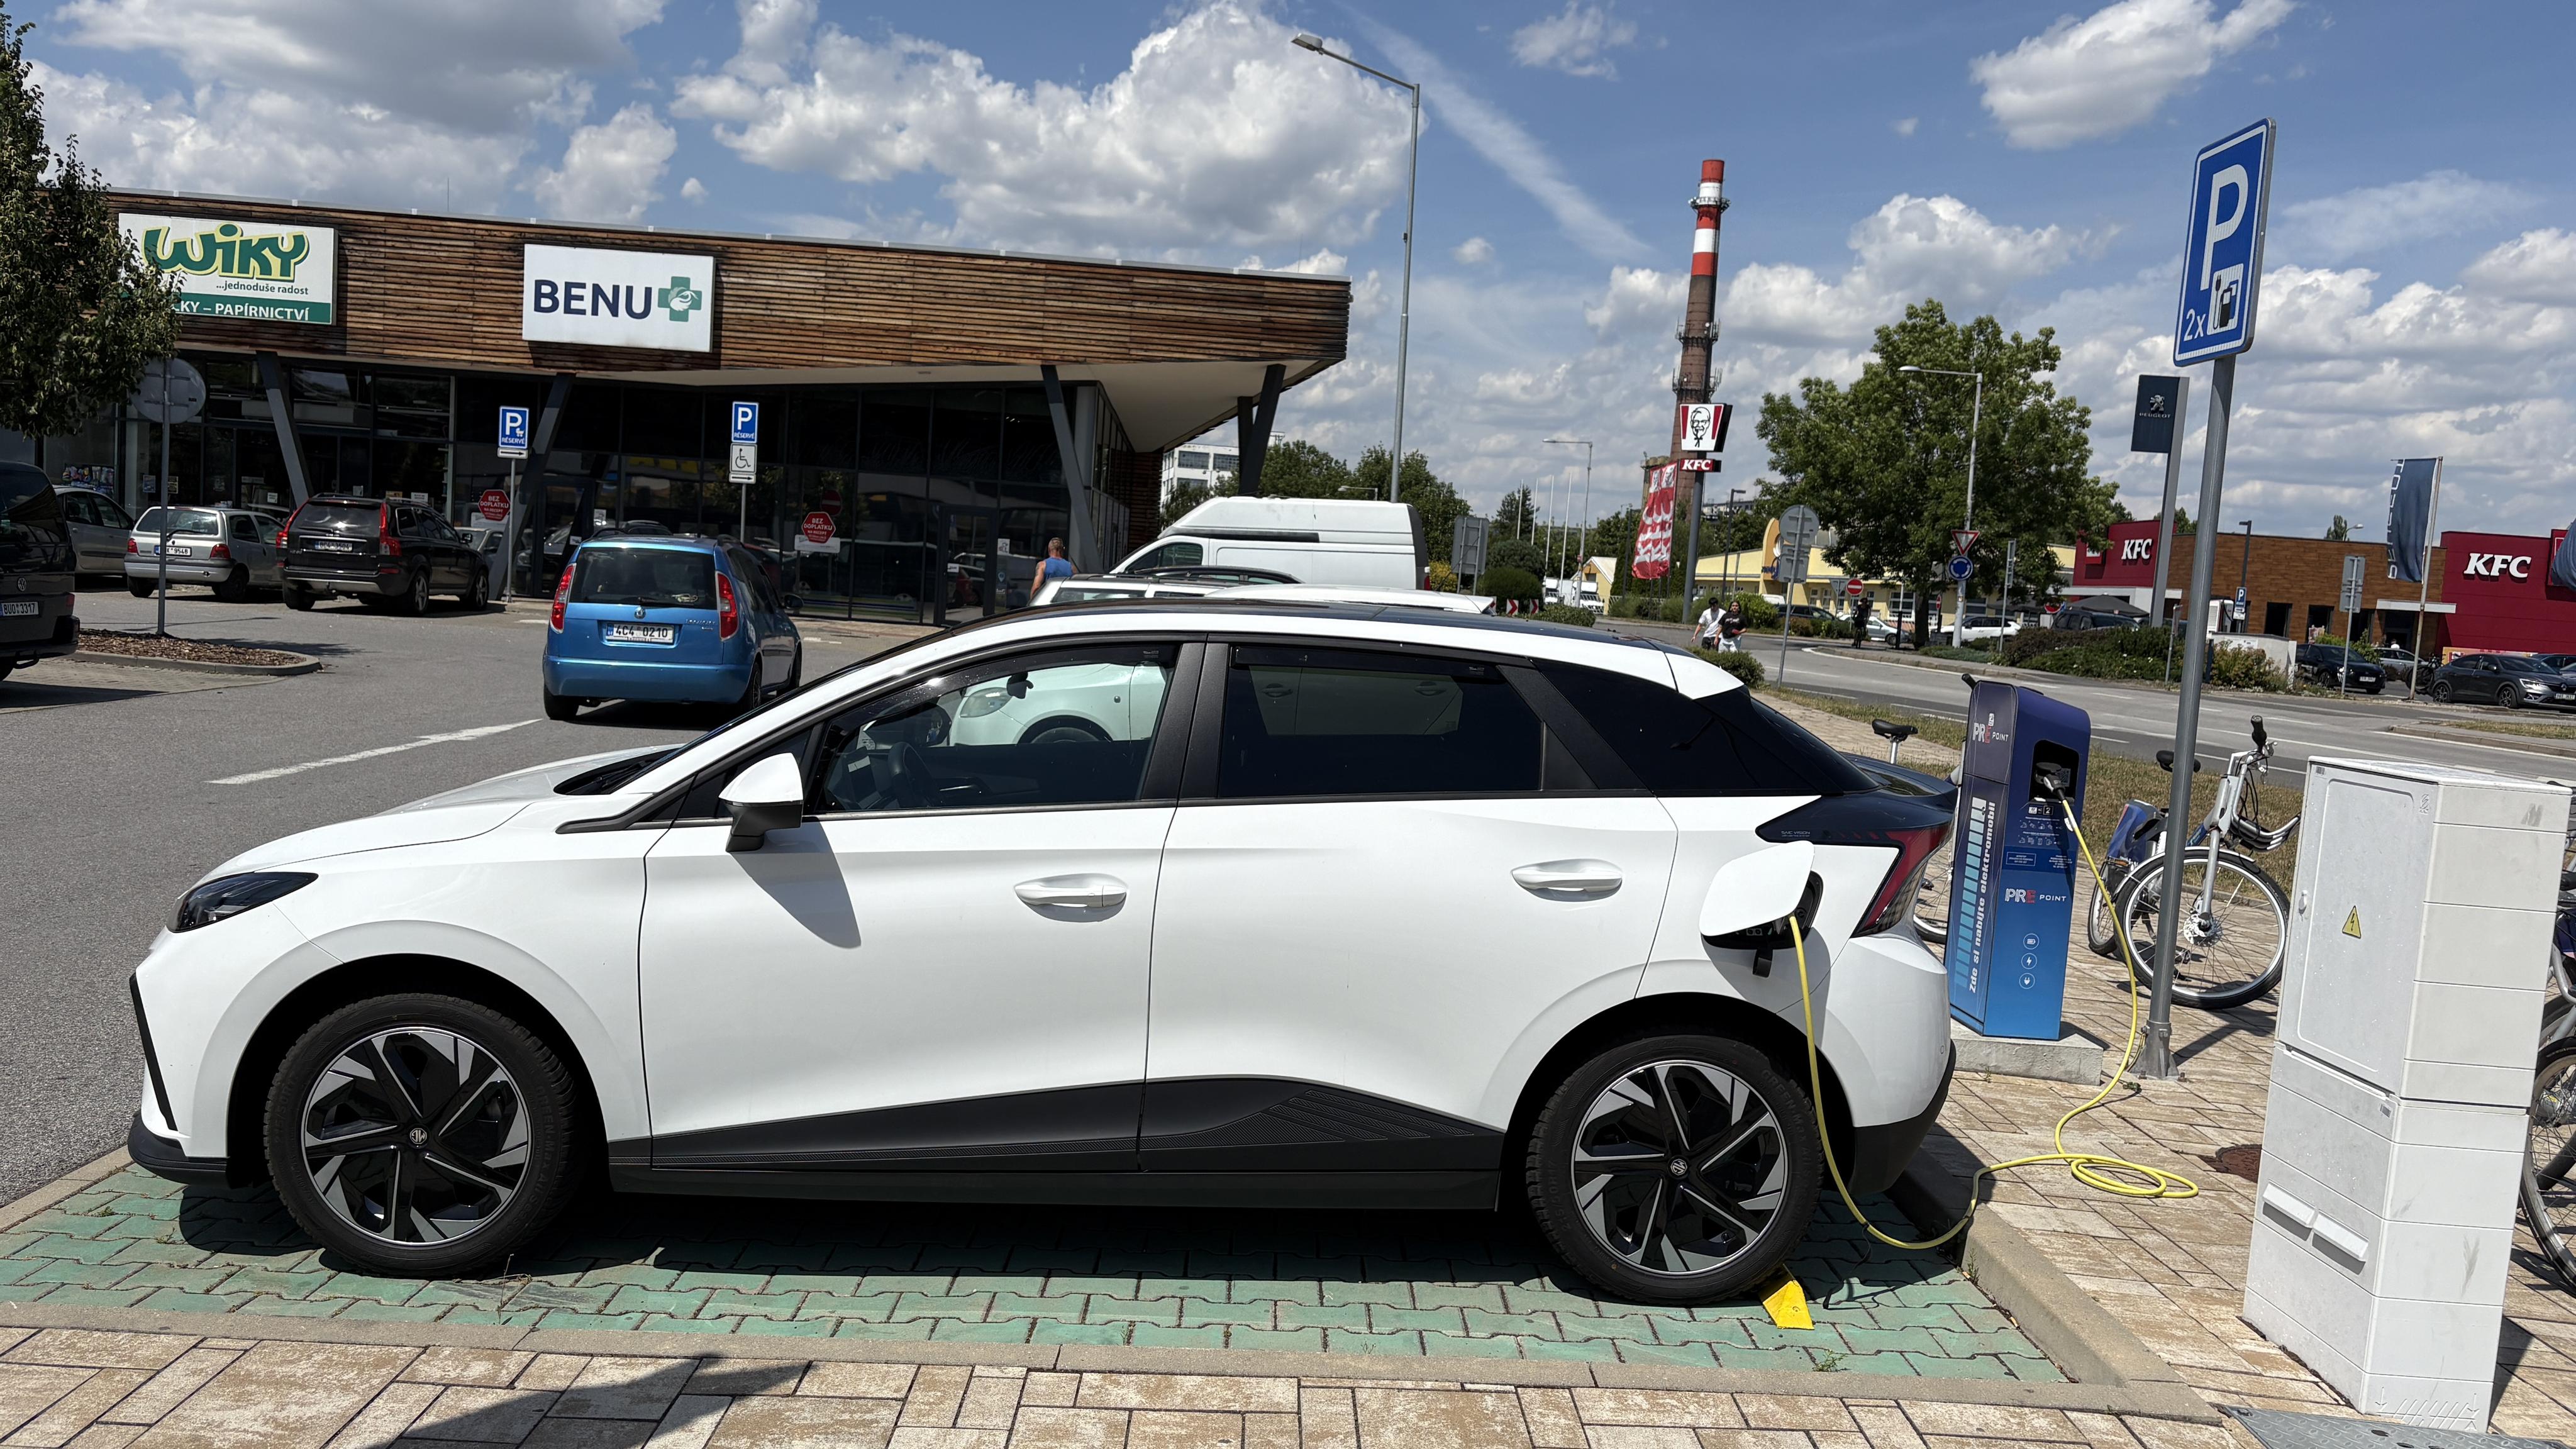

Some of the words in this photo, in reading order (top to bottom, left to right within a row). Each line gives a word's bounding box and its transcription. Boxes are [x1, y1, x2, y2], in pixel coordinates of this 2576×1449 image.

[2200, 164, 2248, 291] P
[277, 285, 309, 295] radost
[533, 279, 652, 319] BENU
[215, 303, 309, 321] PAPÍRNICTVÍ
[2183, 308, 2207, 342] 2x
[505, 412, 522, 435] P
[737, 407, 752, 430] P
[1682, 459, 1711, 470] KFC
[2121, 538, 2152, 560] KFC
[2463, 553, 2531, 578] KFC
[2238, 589, 2244, 601] P
[21, 603, 35, 614] 3317
[616, 625, 634, 636] 4C4
[643, 626, 668, 638] 0210
[1972, 722, 1992, 744] PRE
[1992, 731, 2009, 741] POINT
[1973, 950, 1980, 964] si
[1980, 801, 1996, 894] elektromobil
[2005, 888, 2036, 904] PRE
